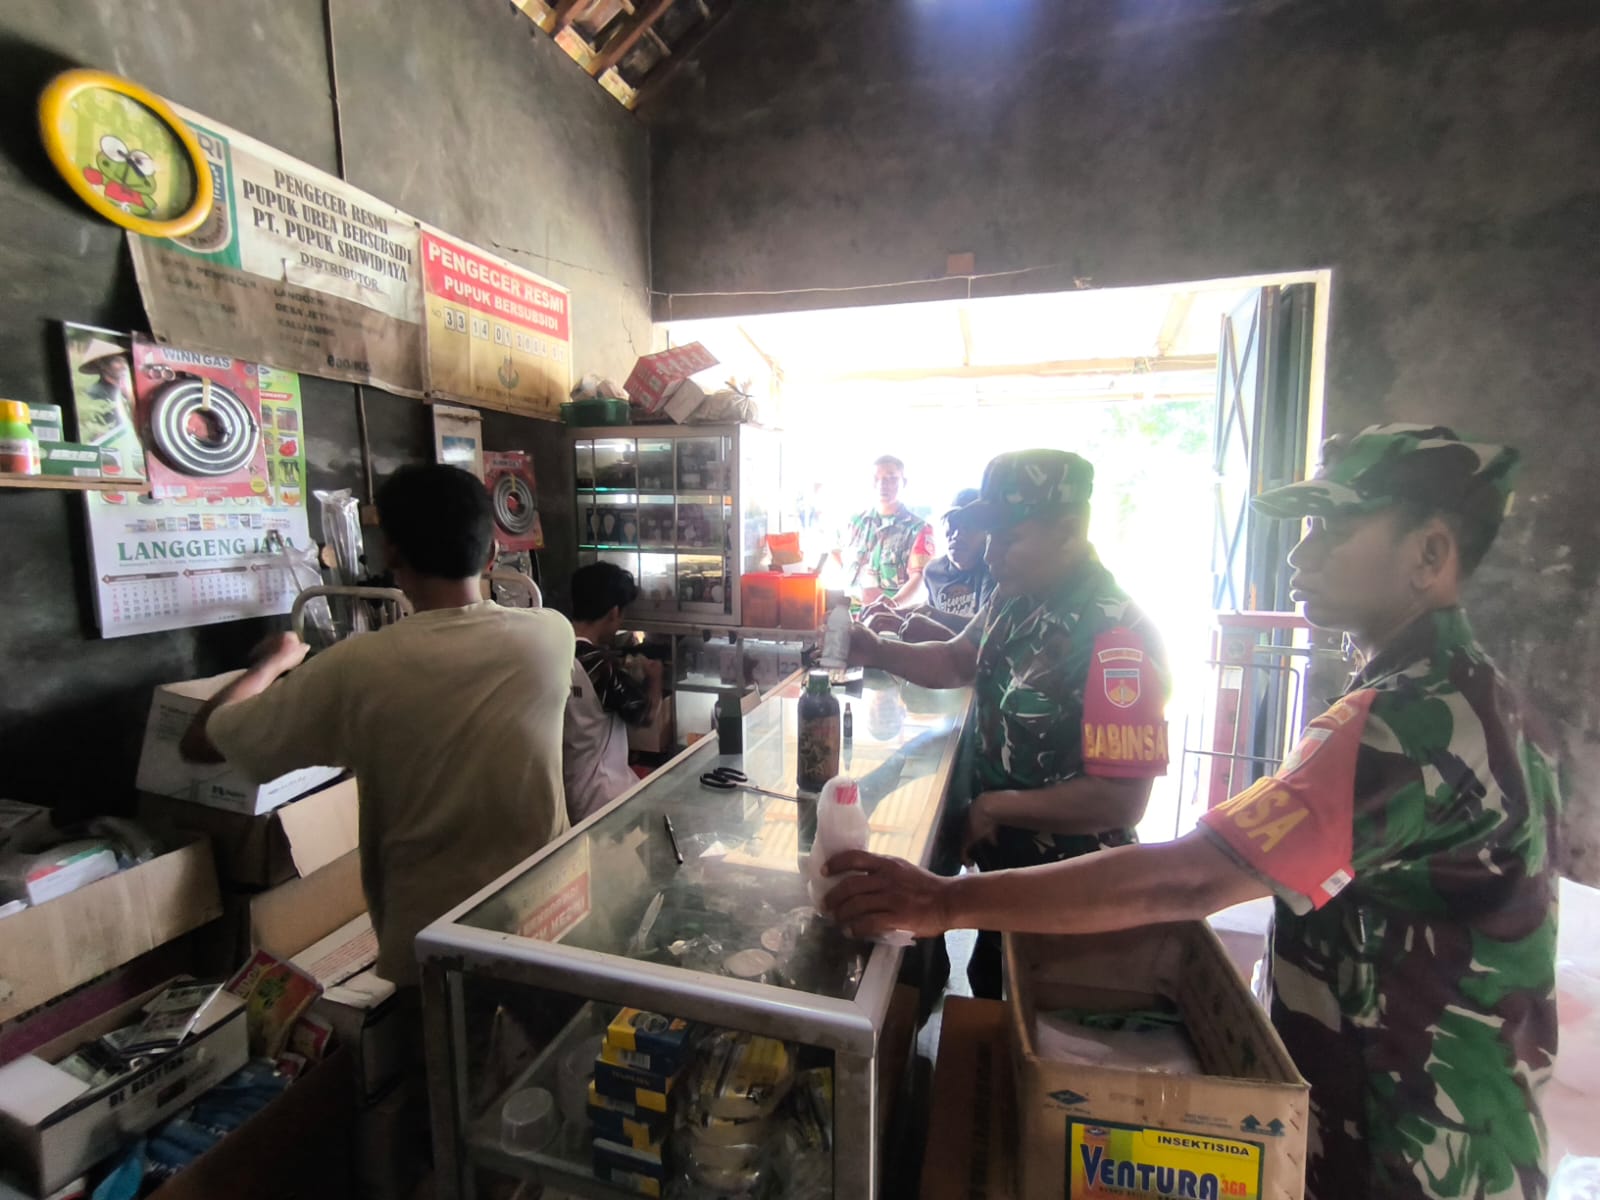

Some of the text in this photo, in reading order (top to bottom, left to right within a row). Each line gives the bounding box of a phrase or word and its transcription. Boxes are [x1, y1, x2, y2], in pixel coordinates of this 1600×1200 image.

[242, 179, 297, 219] PUPUK
[302, 202, 338, 234] UREA
[342, 219, 412, 265] BERSUBSIDI
[274, 169, 389, 235] PENGECER RESMI
[252, 207, 280, 234] PT.
[285, 222, 335, 255] PUPUK
[300, 251, 379, 291] DISTRIBUTOR
[428, 240, 564, 315] PENGECER RESMI
[444, 275, 559, 331] PUPUK BERSUBSIDI
[202, 353, 231, 369] GAS
[117, 538, 246, 561] LANGGENG
[1157, 1135, 1250, 1157] INSEKTISIDA
